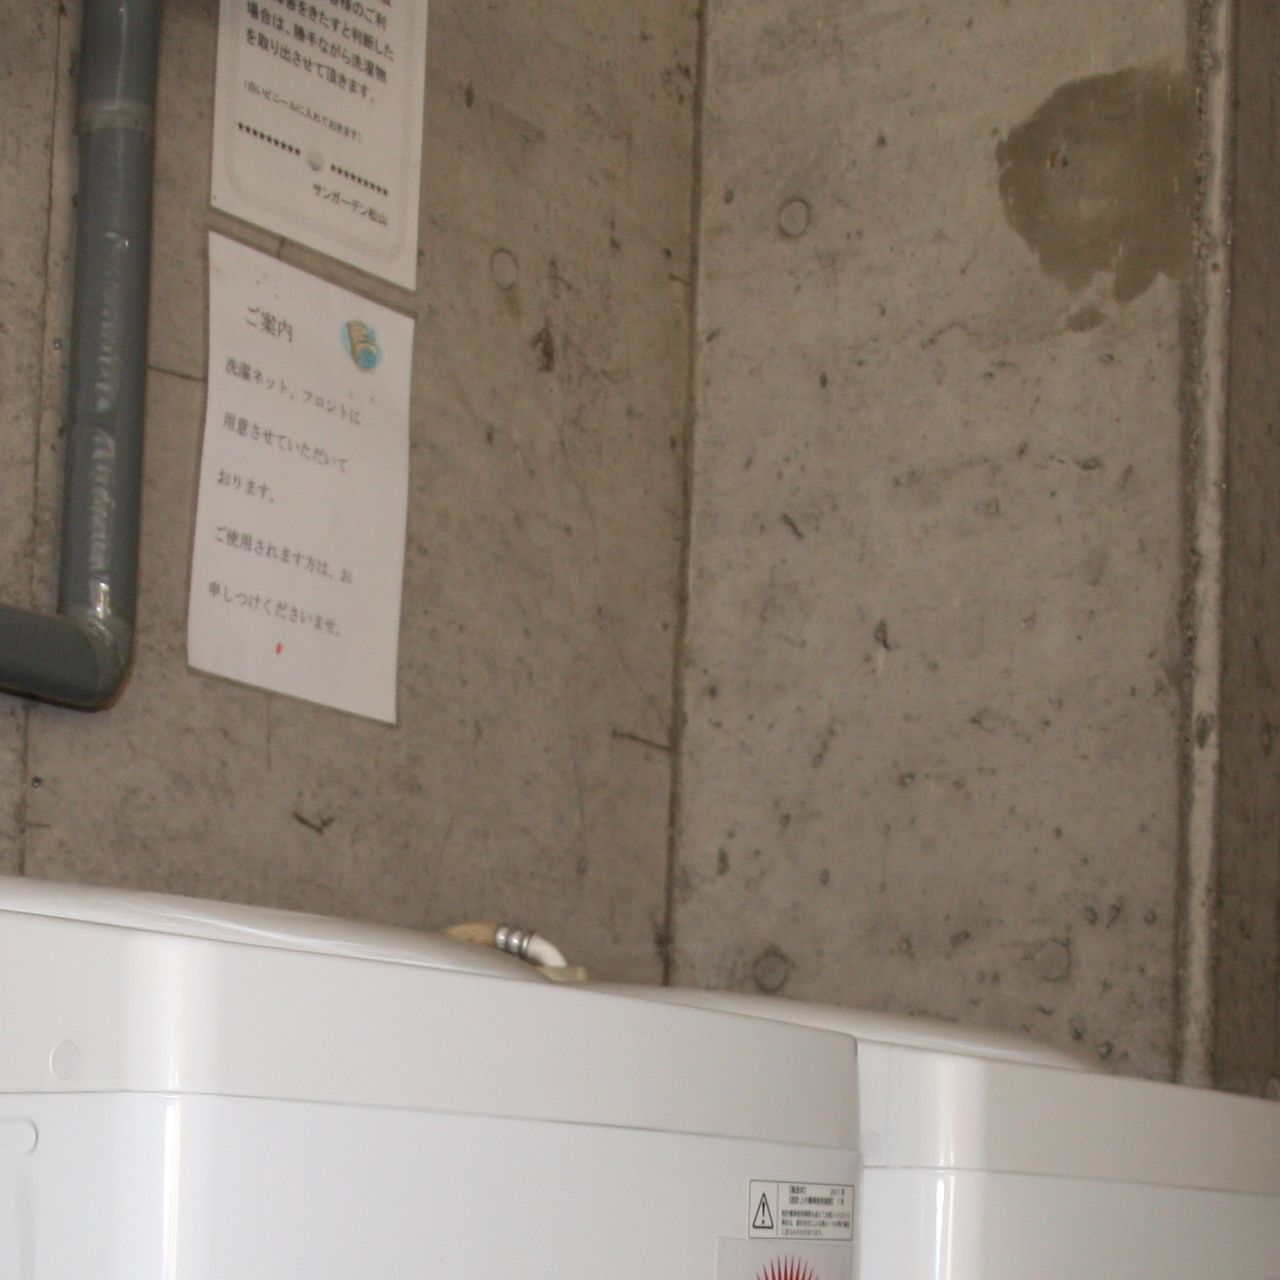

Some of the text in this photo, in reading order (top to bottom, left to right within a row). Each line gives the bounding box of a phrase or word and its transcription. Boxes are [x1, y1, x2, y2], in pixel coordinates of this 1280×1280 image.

[245, 305, 294, 343] ご案内
[222, 411, 349, 473] 用意させていただいて
[216, 470, 274, 503] おります。
